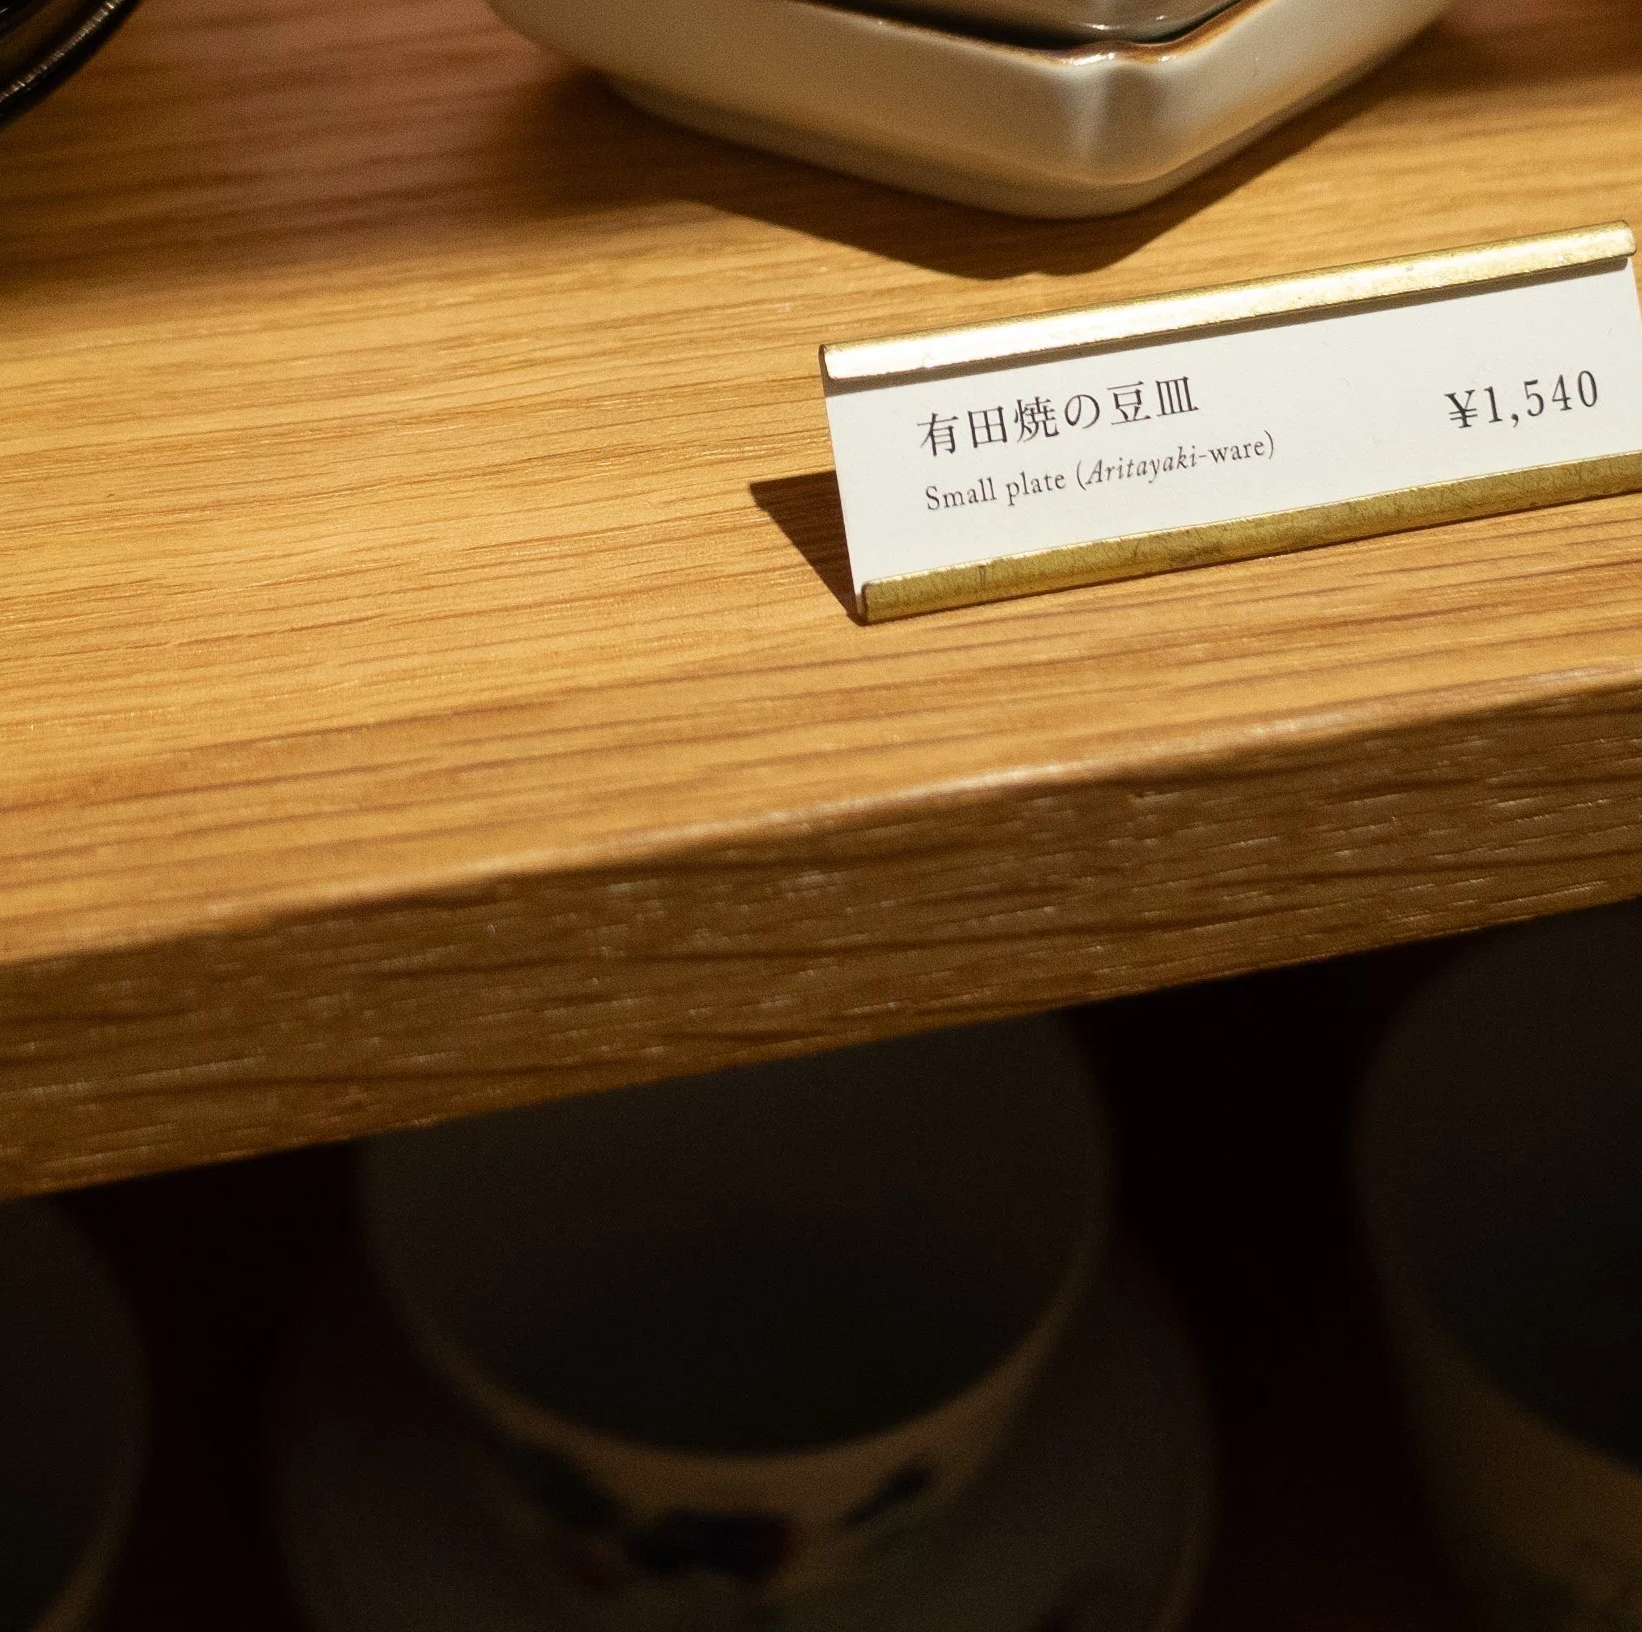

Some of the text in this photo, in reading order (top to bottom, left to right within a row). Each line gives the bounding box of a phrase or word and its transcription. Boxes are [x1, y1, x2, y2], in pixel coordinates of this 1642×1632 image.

[916, 375, 1200, 458] 有田焼の豆皿
[1443, 369, 1598, 430] ¥1,540
[924, 429, 1275, 512] Small plate (Aritayaki-ware)
